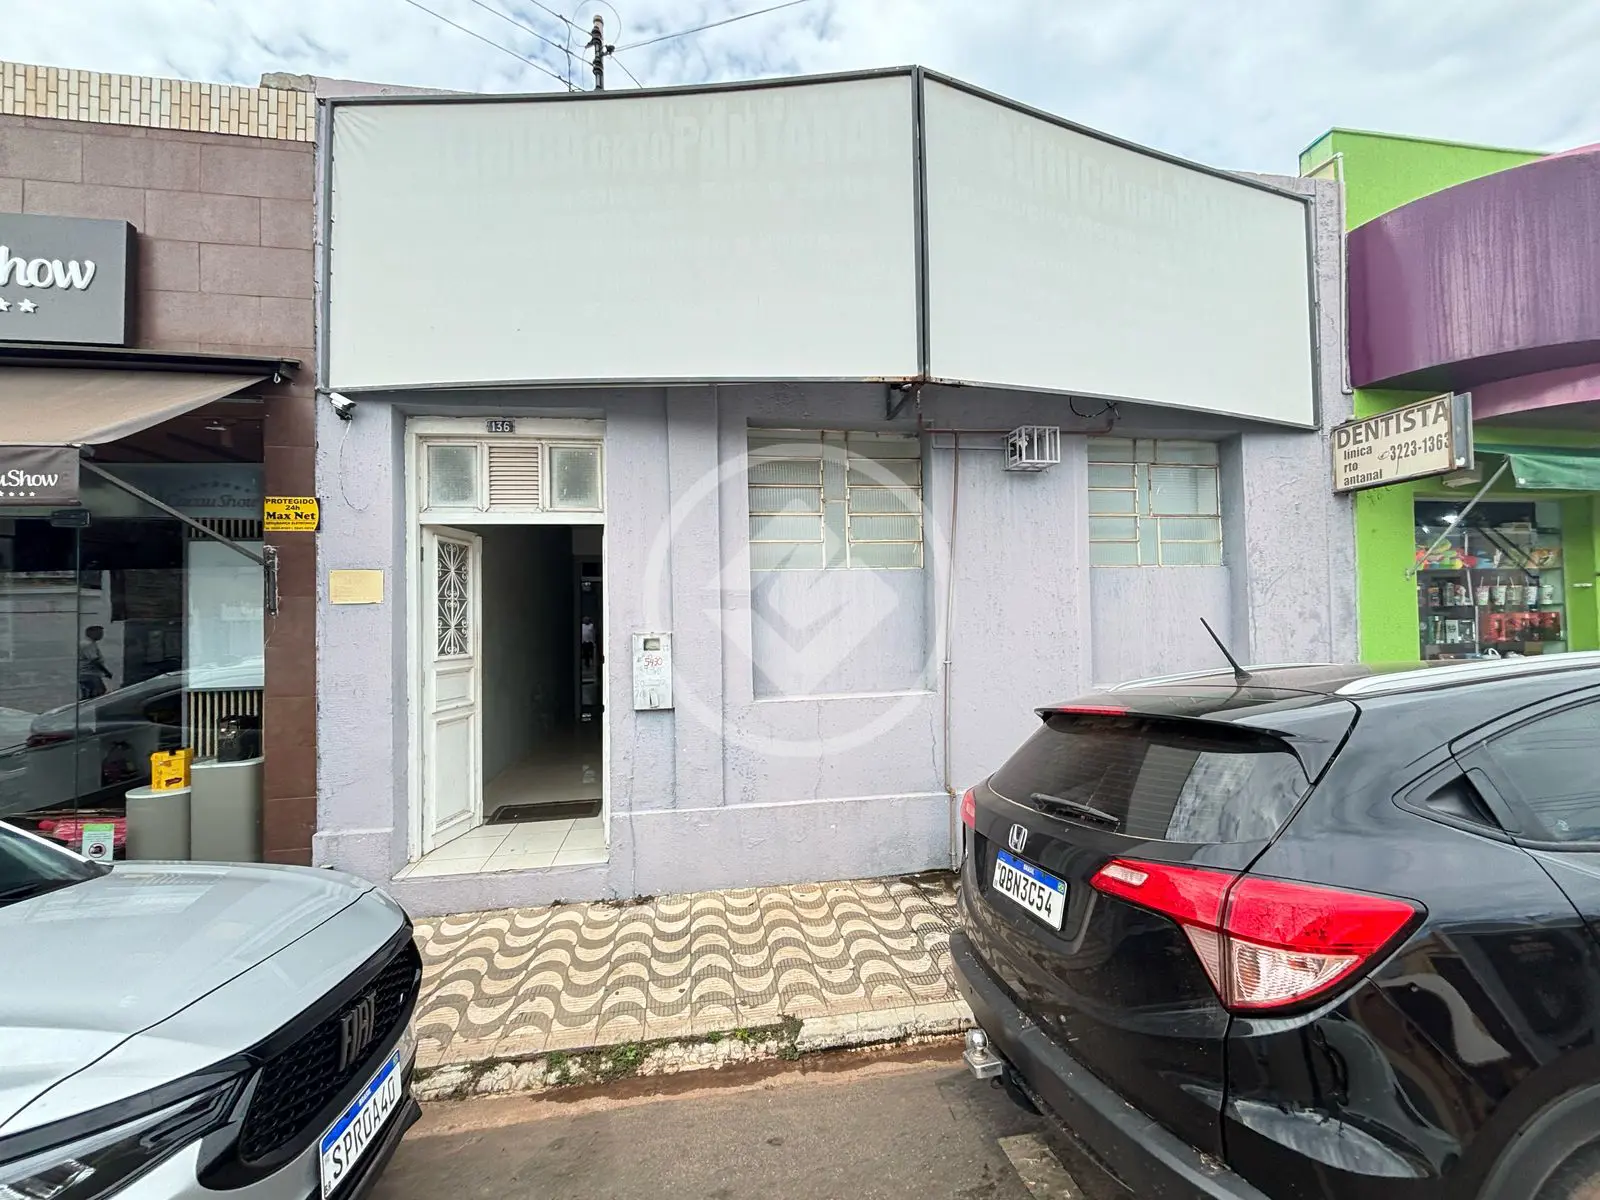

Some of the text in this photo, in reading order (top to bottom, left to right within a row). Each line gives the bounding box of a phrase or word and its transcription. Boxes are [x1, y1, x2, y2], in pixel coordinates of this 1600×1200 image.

[491, 421, 510, 432] 136
[1337, 401, 1448, 449] DENTISTA
[1390, 432, 1449, 461] 3223-1363
[1344, 462, 1358, 473] rto
[1344, 468, 1382, 486] antanal
[266, 511, 316, 520] Max Net
[998, 865, 1052, 918] QBN3C54
[338, 990, 377, 1073] FIAT
